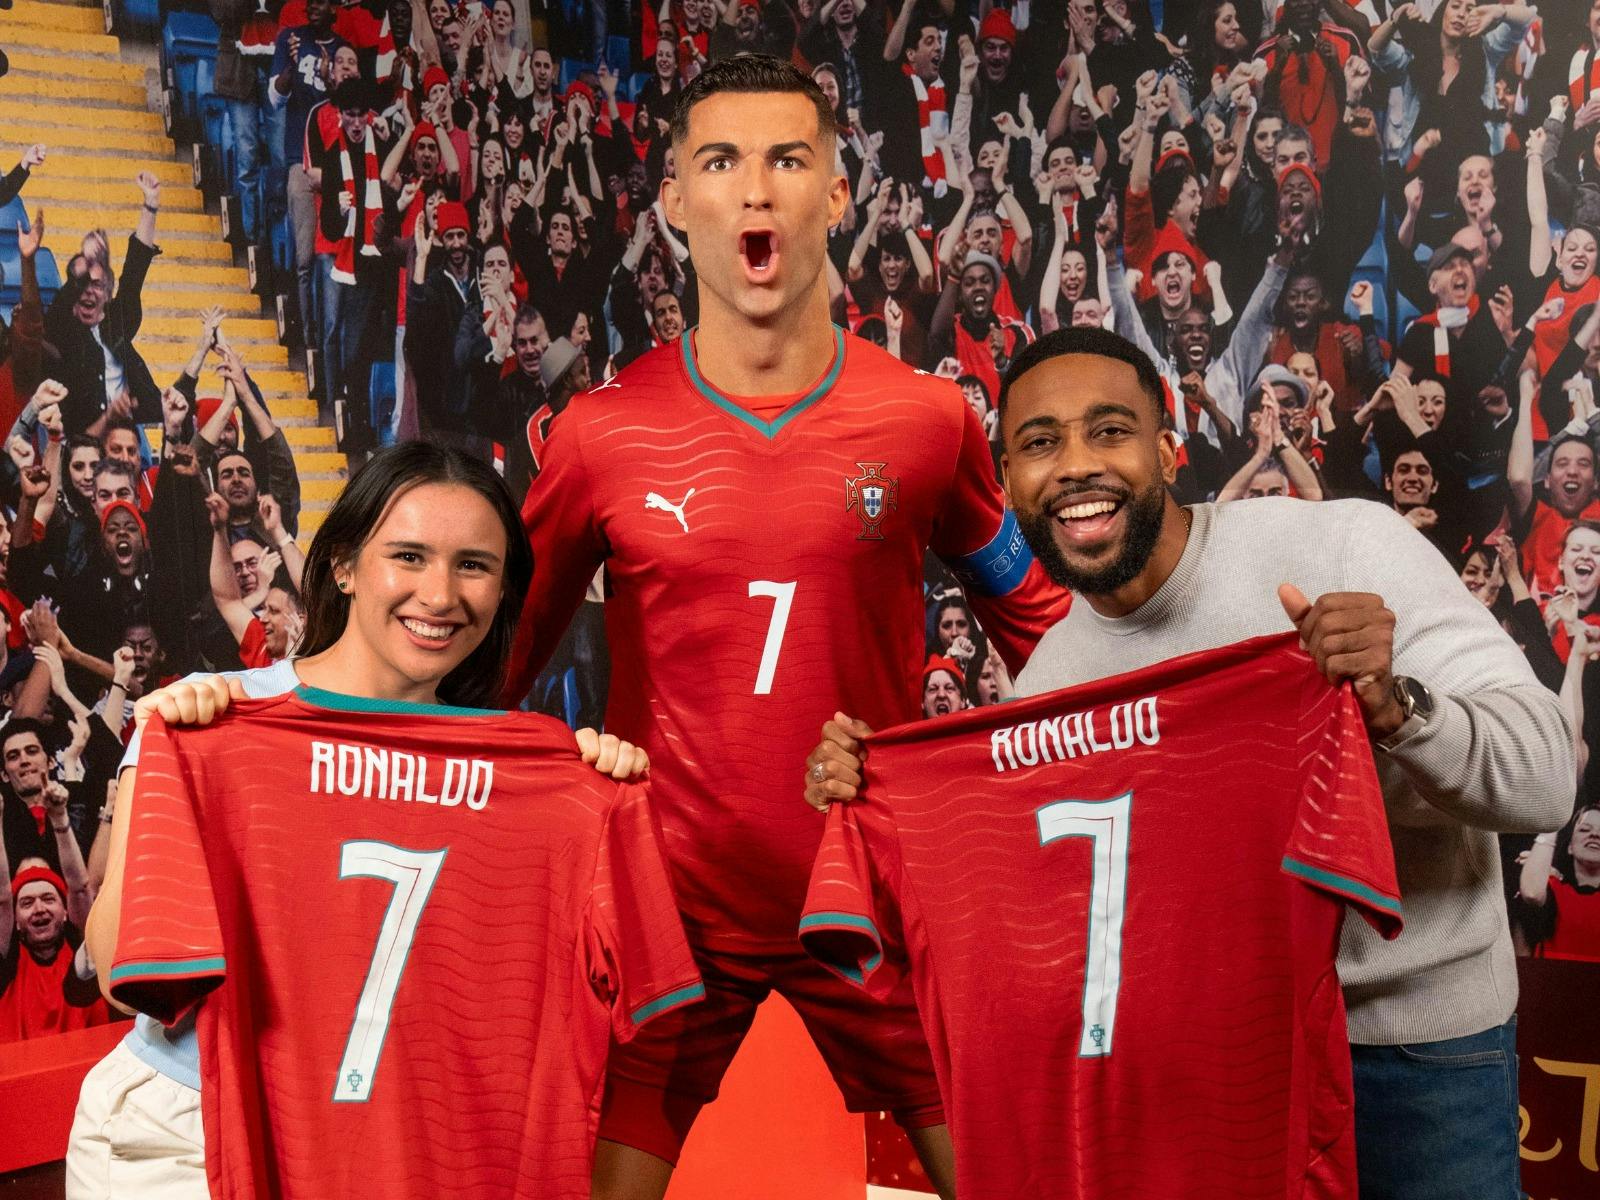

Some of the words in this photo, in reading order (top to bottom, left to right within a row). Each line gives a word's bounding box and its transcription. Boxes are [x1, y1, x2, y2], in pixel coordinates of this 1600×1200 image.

[748, 579, 798, 695] 7
[309, 740, 495, 811] RONALDO
[991, 695, 1162, 773] RONALDO
[332, 839, 449, 1103] 7
[1035, 791, 1133, 1058] 7
